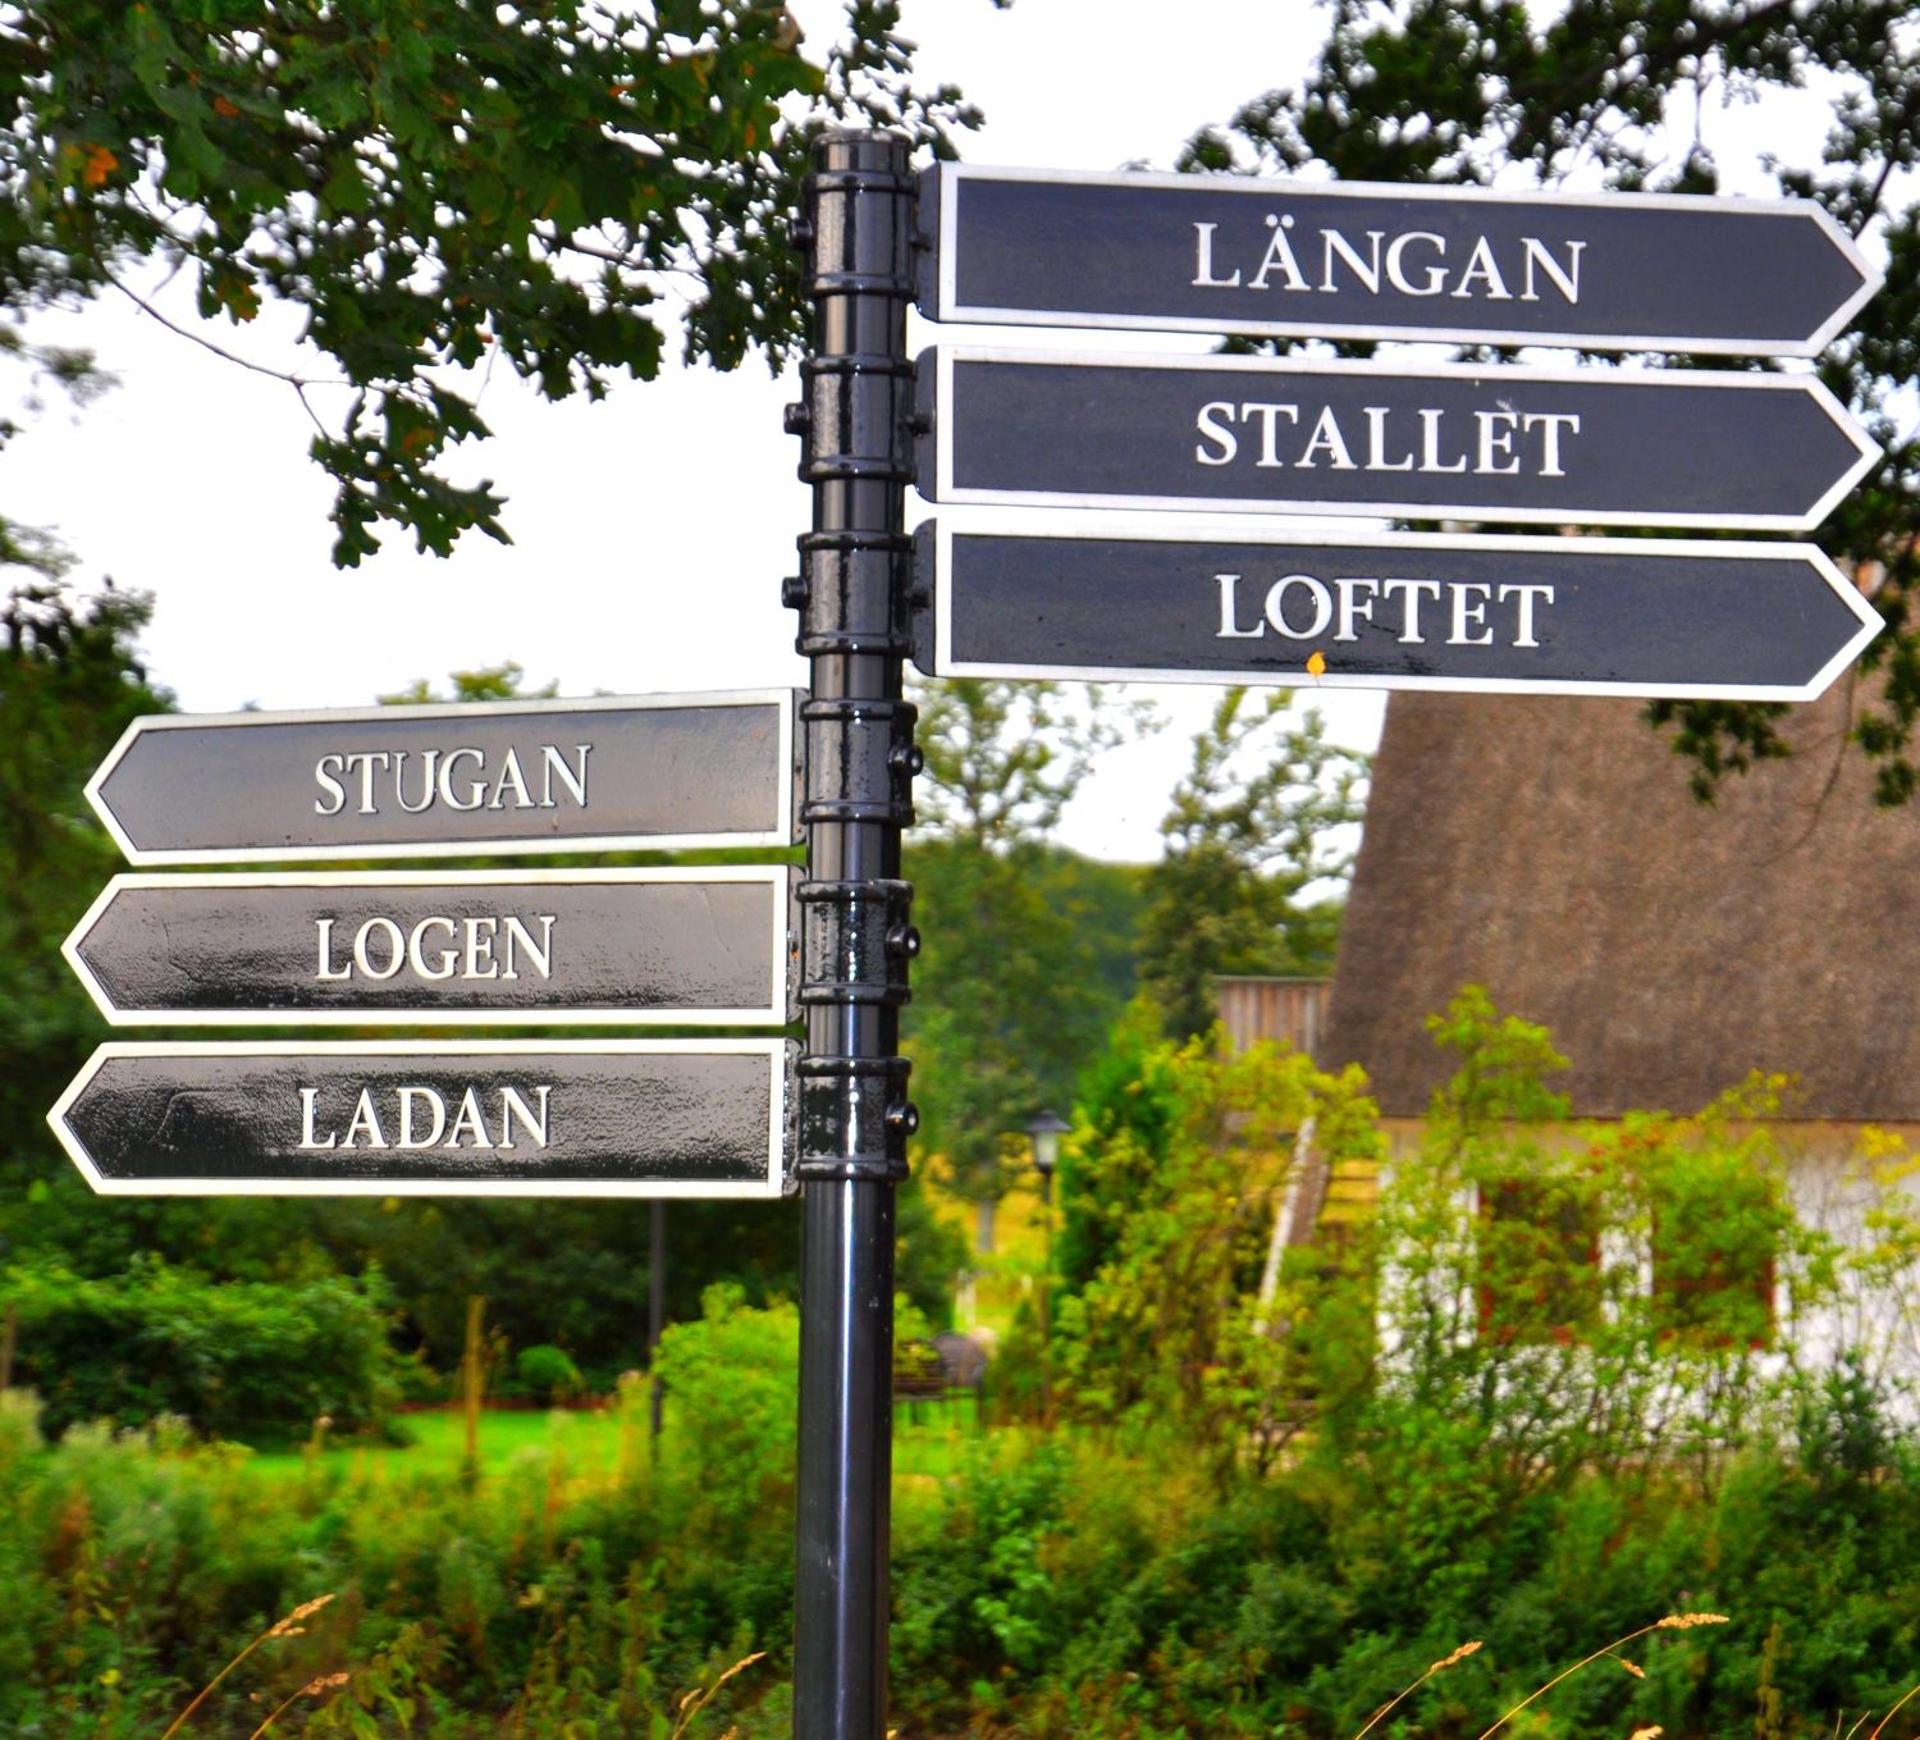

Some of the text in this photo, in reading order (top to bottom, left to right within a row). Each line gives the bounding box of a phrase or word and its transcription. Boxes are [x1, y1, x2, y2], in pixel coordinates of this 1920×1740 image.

[1191, 213, 1587, 305] LÄNGAN
[1195, 401, 1581, 478] STALLET
[1214, 573, 1555, 648] LOFTET
[314, 744, 592, 815] STUGAN
[315, 914, 556, 981] LOGEN
[297, 1085, 551, 1150] LADAN
